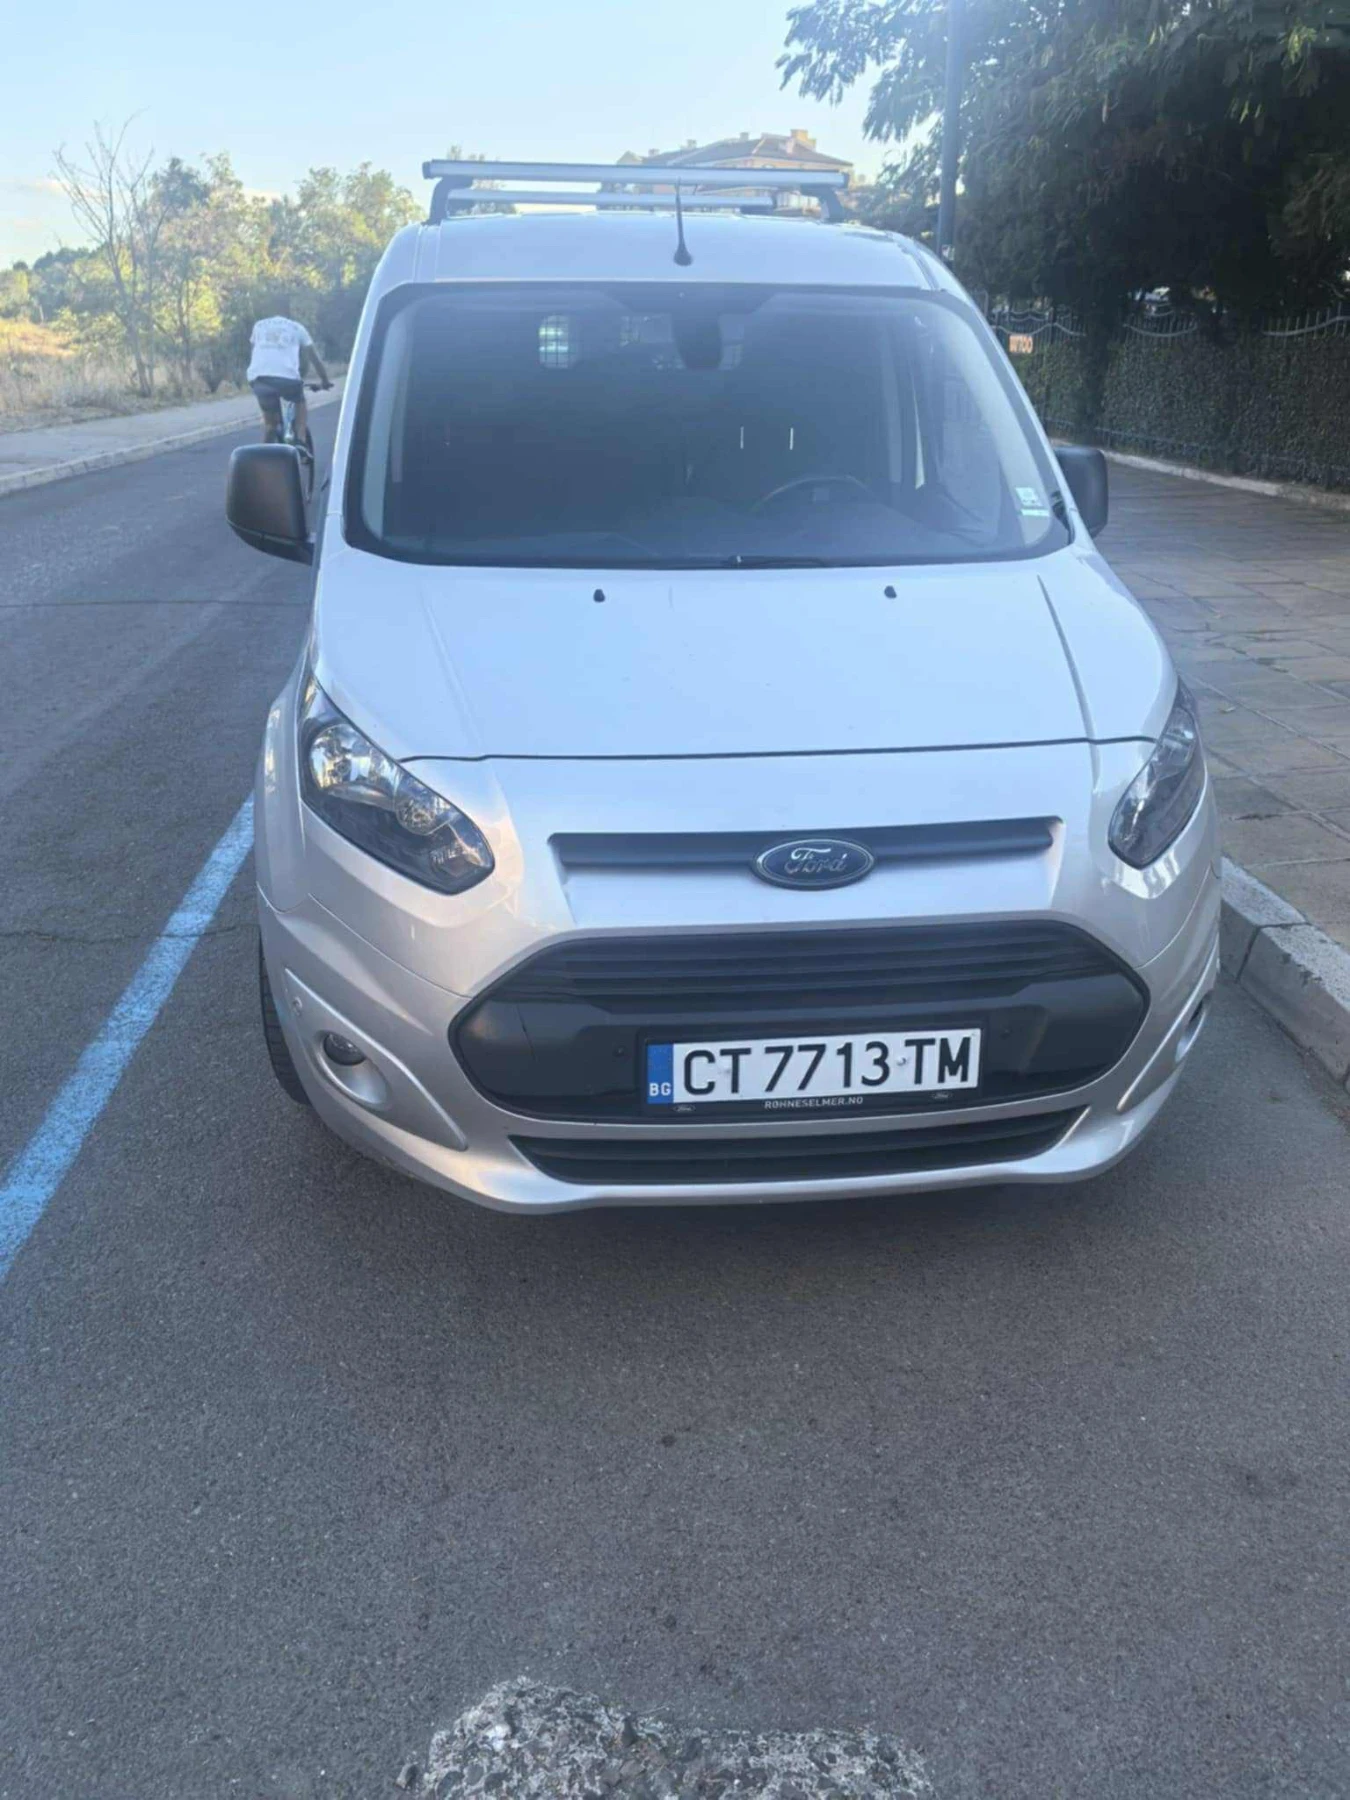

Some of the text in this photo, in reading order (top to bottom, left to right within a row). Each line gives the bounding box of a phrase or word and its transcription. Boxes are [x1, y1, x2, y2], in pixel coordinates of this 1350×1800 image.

[784, 847, 848, 874] Ford
[683, 1036, 971, 1096] CT 7713 TM
[649, 1082, 671, 1097] BG
